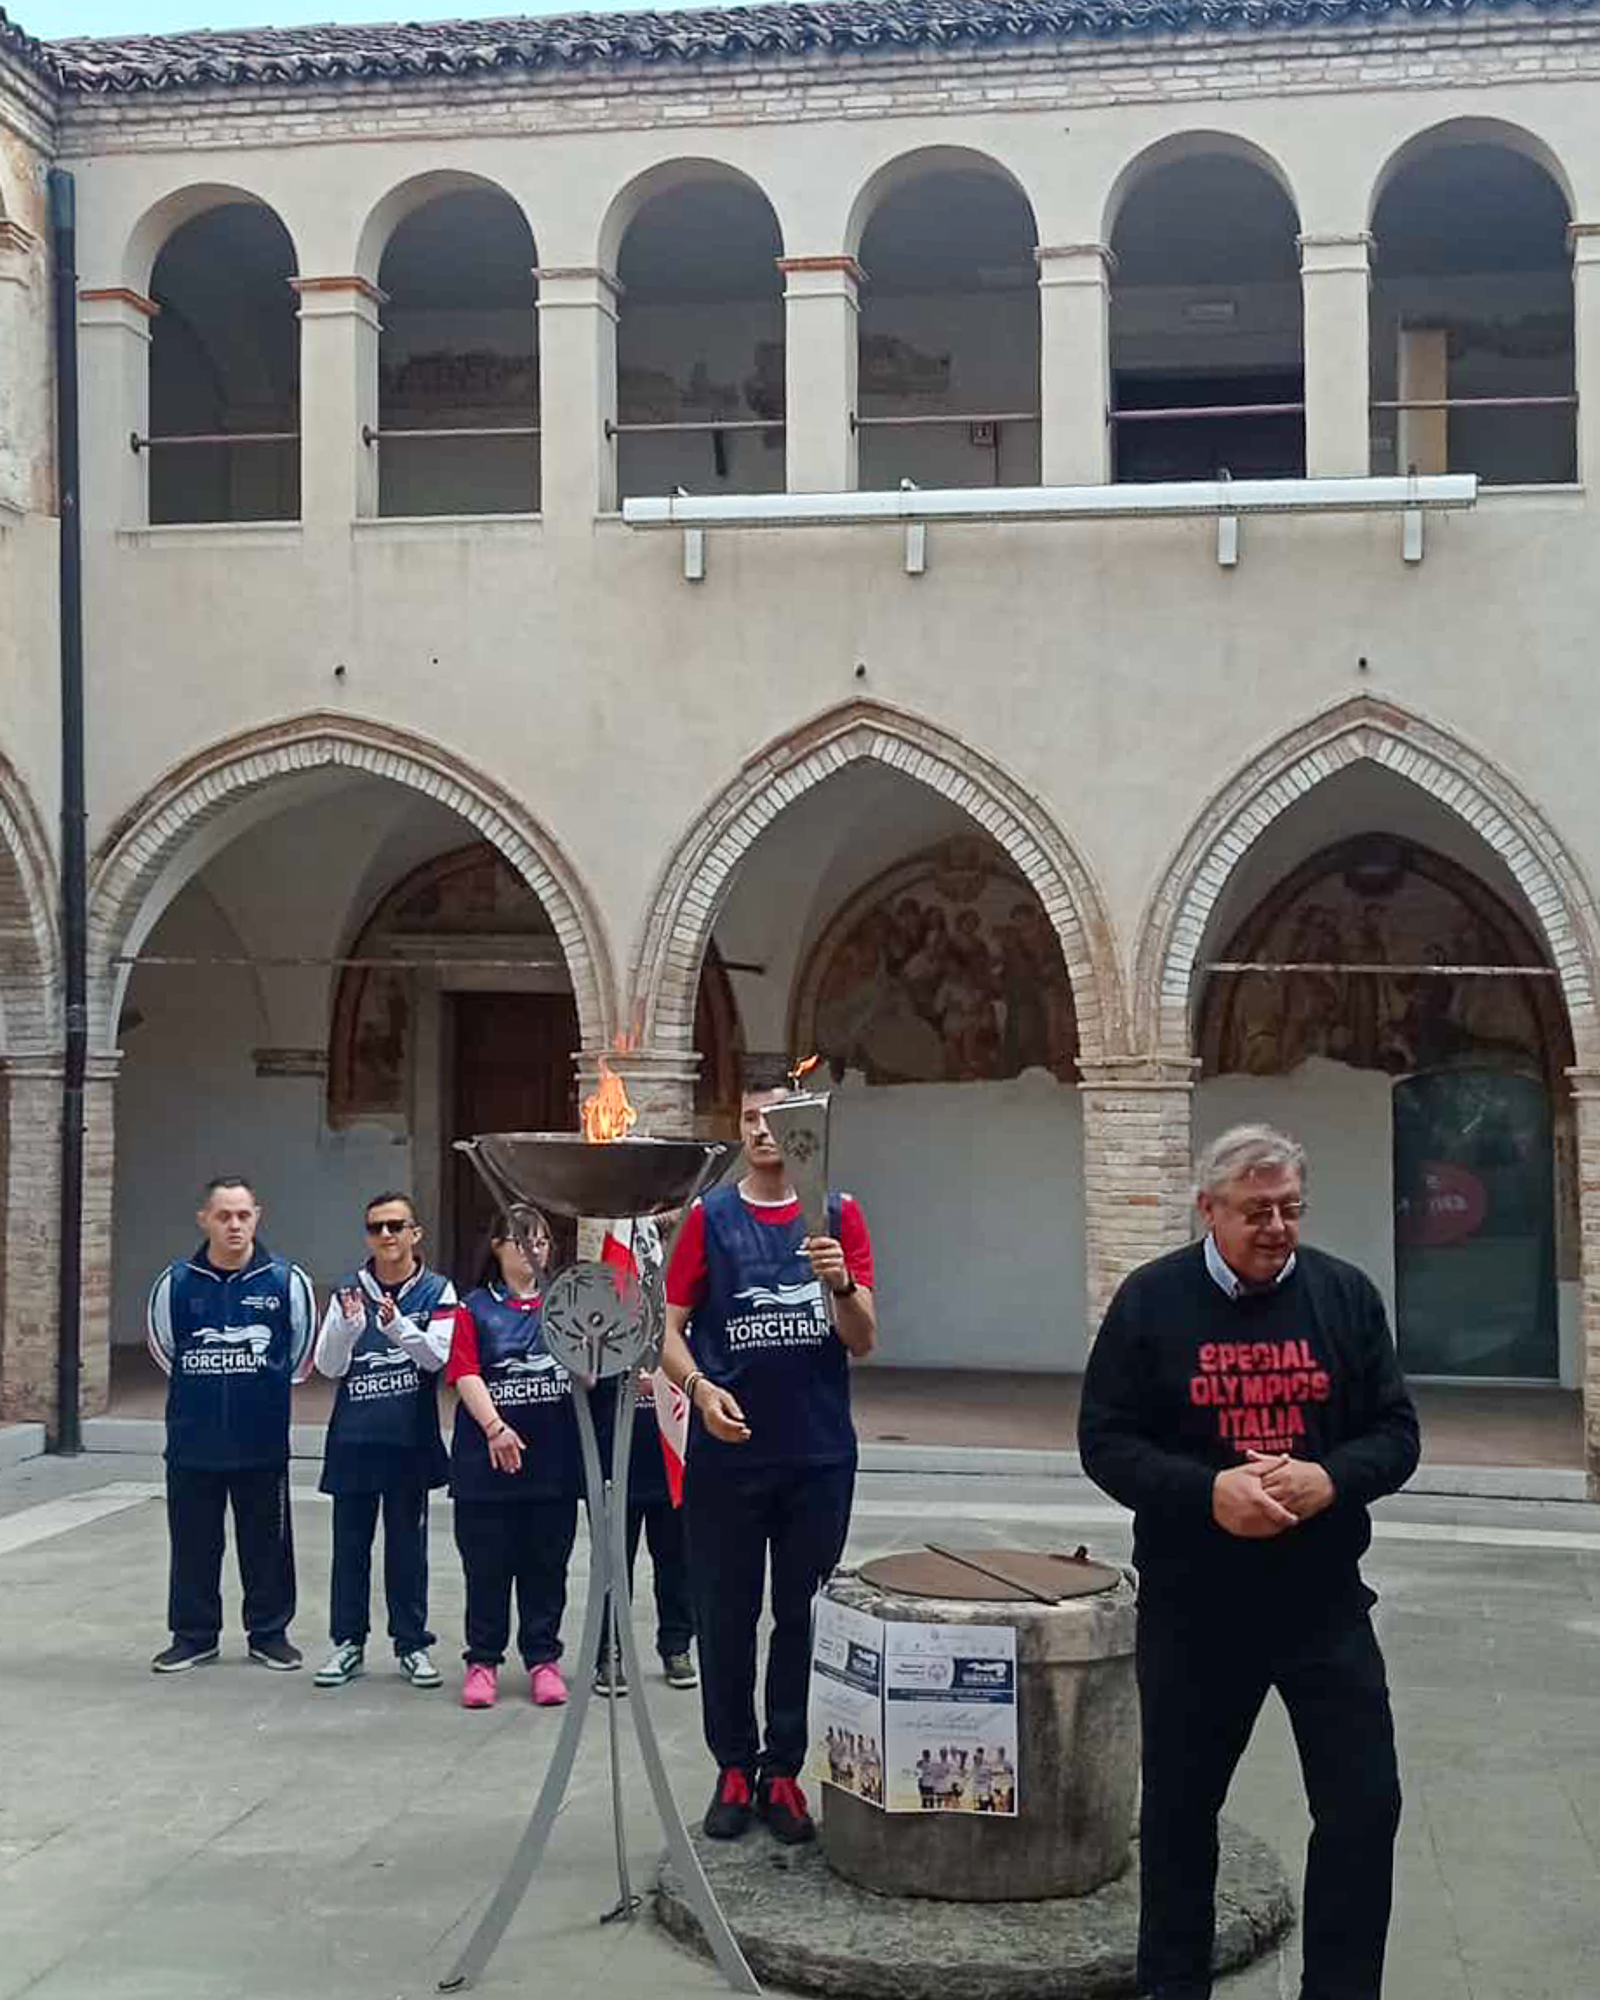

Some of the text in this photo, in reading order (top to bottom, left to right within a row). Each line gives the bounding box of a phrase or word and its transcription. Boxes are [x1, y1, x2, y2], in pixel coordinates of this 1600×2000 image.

[725, 1319, 831, 1343] TORCH RUN
[181, 1354, 267, 1369] TORCH RUN
[1200, 1341, 1316, 1371] SPECIAL
[346, 1375, 402, 1396] TORCH
[540, 1380, 572, 1396] RUN
[1191, 1372, 1330, 1405] OLYMPICS
[1219, 1407, 1305, 1436] ITALIA
